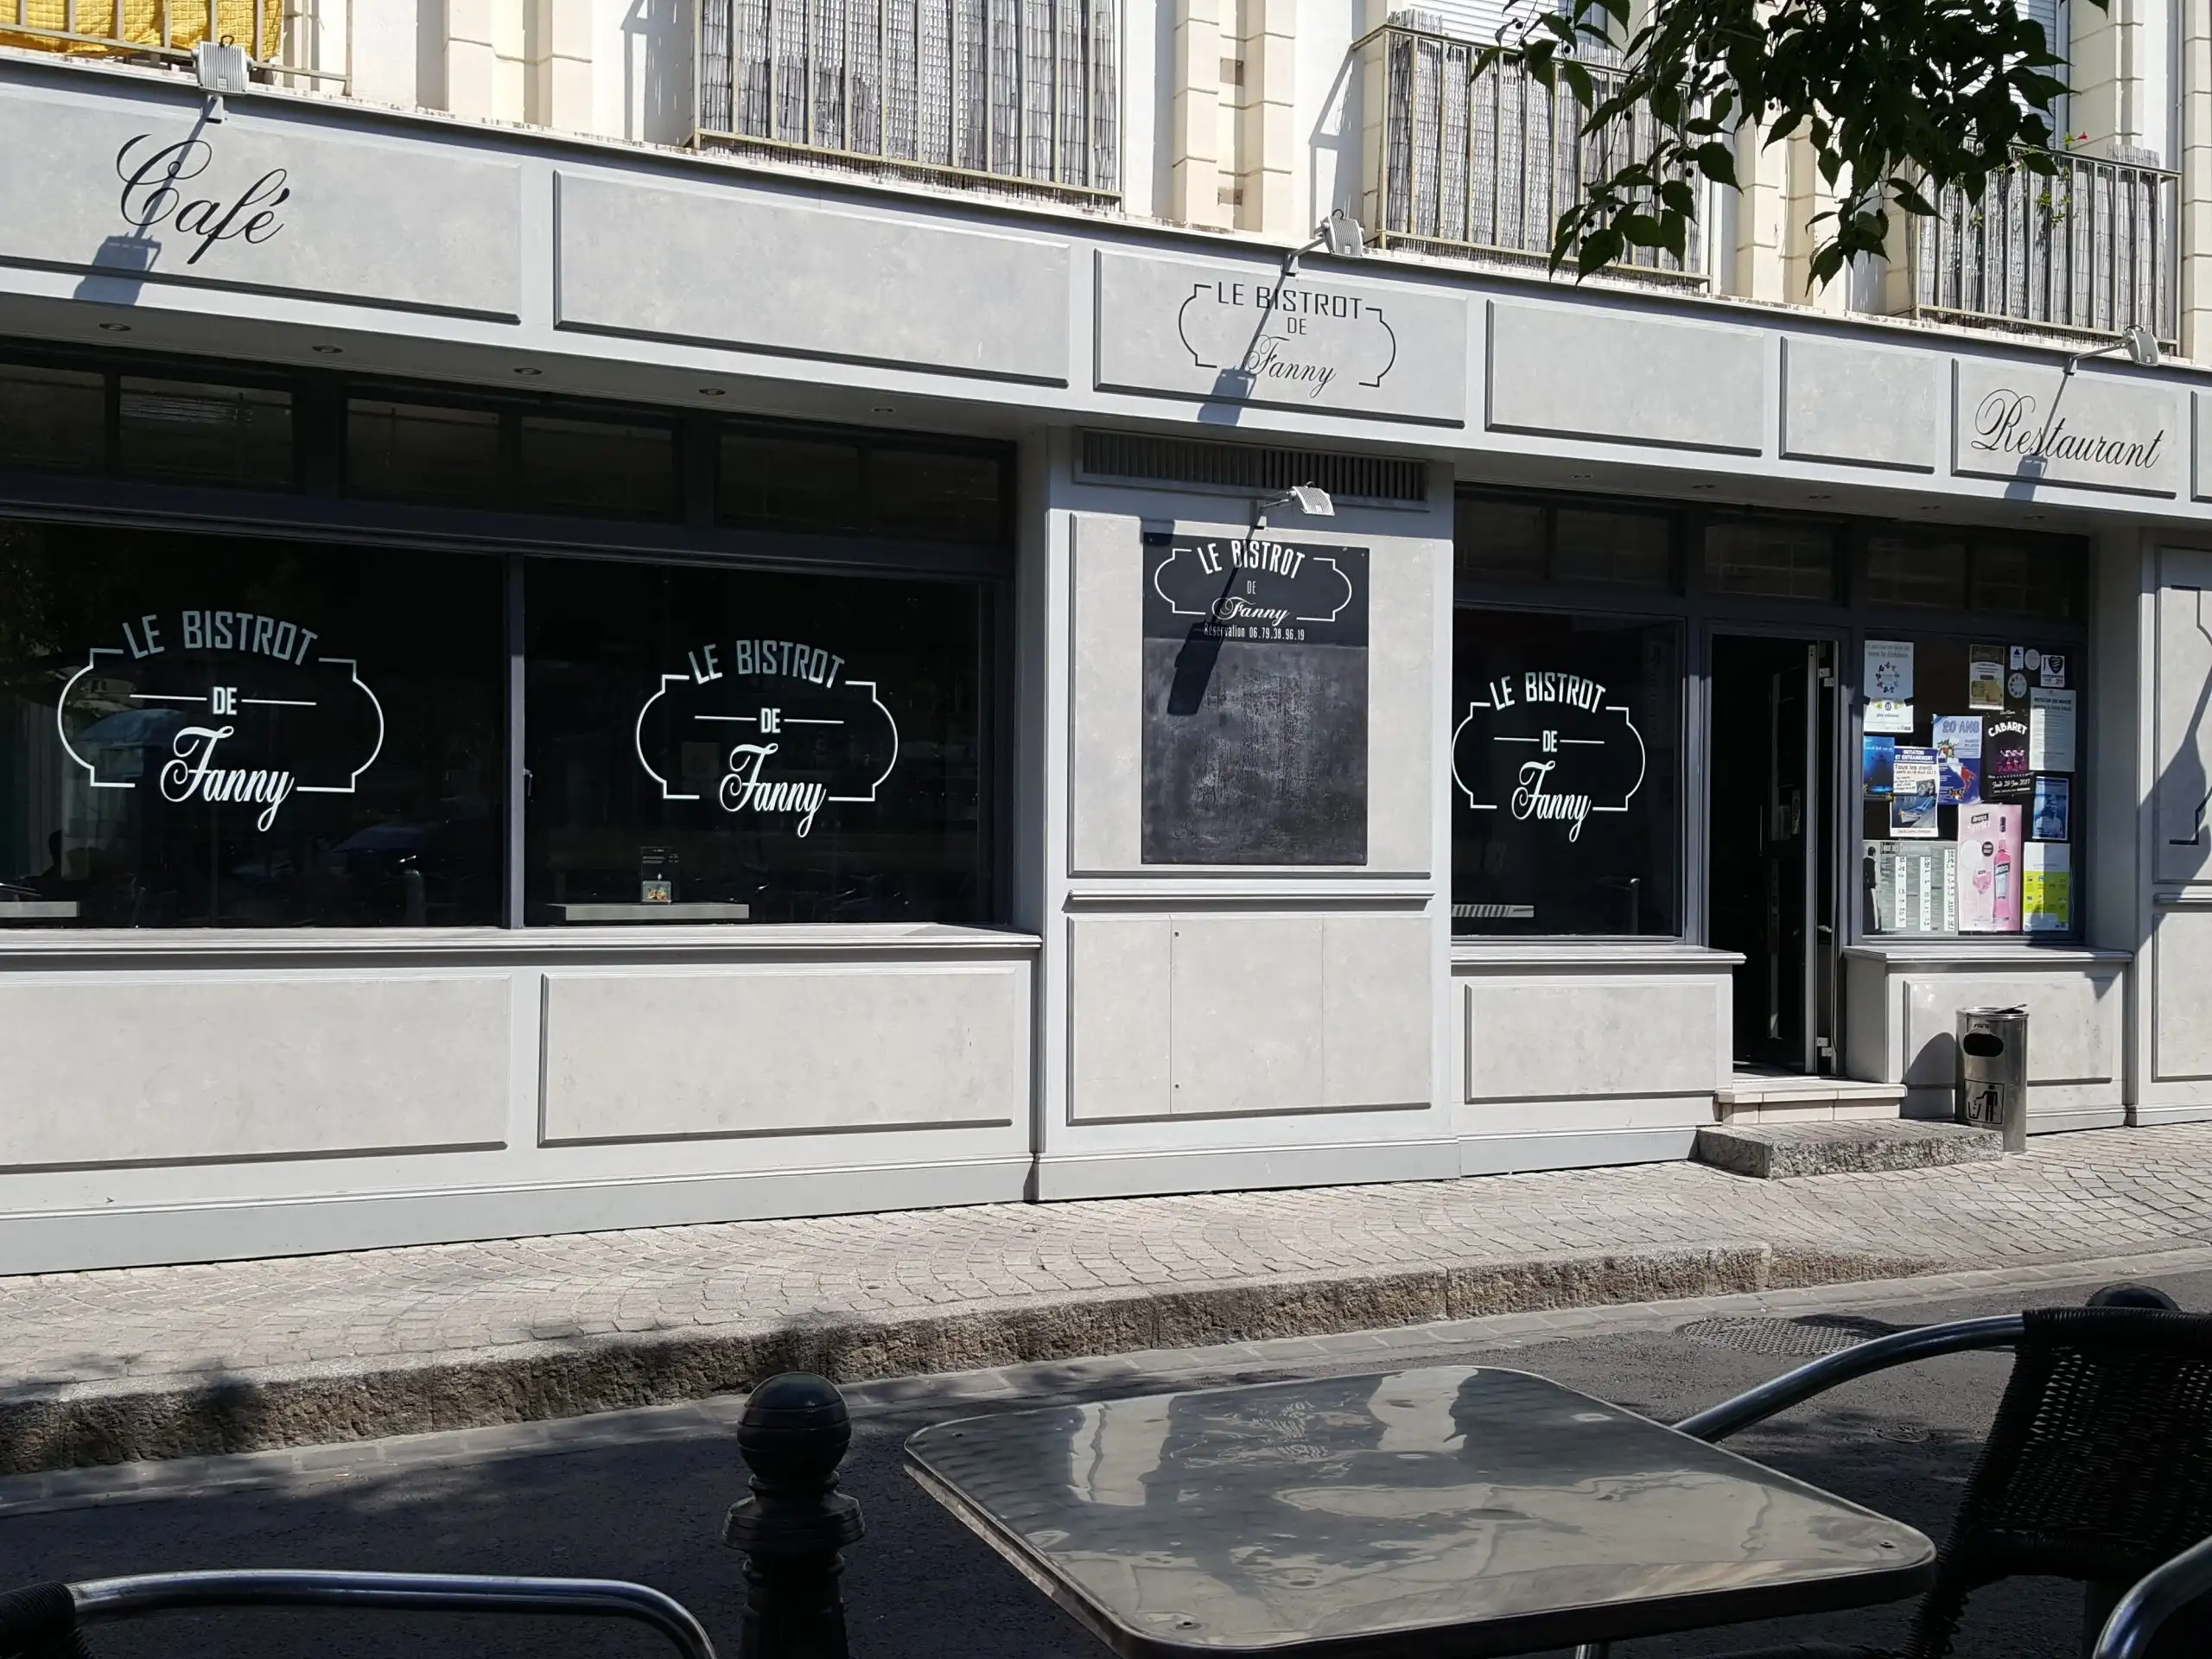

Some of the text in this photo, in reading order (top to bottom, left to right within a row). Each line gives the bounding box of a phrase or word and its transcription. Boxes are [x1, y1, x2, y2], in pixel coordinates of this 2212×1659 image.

[116, 134, 290, 264] Café
[1217, 281, 1363, 319] LE BISTROT
[1287, 316, 1307, 335] DE
[1243, 334, 1337, 398] Fanny
[1971, 388, 2164, 468] Restaurant
[1197, 539, 1306, 579] LE BISTROT
[1247, 581, 1256, 594] DE
[1211, 596, 1291, 626] Fanny
[122, 610, 319, 665] LE BISTROT
[1249, 627, 1306, 640] 06.79.38.96.19
[688, 639, 845, 689] LE BISTROT
[212, 686, 238, 715] DE
[1489, 671, 1606, 713] LE BISTROT
[760, 708, 781, 733] DE
[1942, 720, 1956, 733] 20
[1988, 721, 2027, 737] CABARET
[1542, 729, 1558, 753] DE
[160, 725, 296, 832] Fanny
[719, 742, 827, 838] Fanny
[1511, 760, 1592, 842] Fanny
